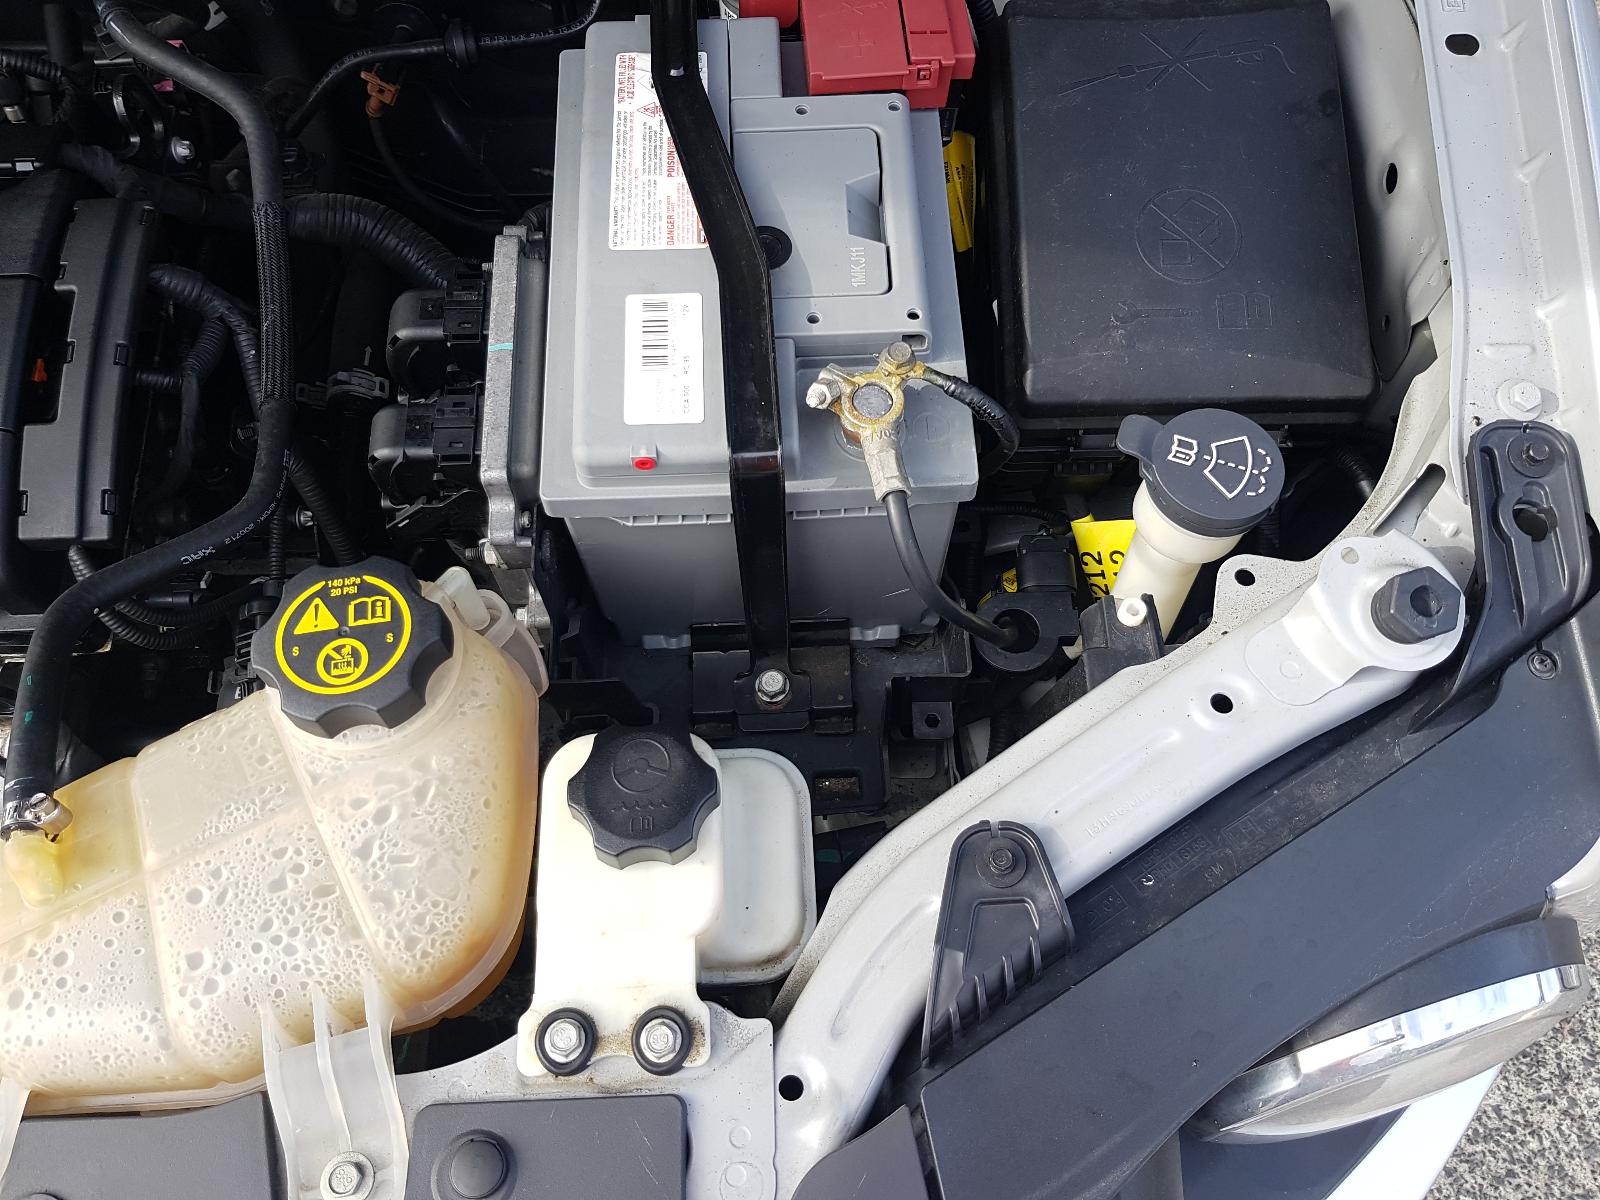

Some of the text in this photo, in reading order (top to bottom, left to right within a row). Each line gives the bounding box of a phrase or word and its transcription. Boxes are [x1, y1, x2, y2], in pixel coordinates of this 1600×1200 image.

[666, 150, 676, 178] POISON
[666, 214, 675, 246] DANGER
[849, 247, 866, 288] 1MKJ11
[327, 576, 361, 588] 140 kPa
[1079, 551, 1110, 596] 212
[330, 585, 358, 597] 20 PSI
[385, 632, 394, 643] S
[291, 646, 300, 656] S
